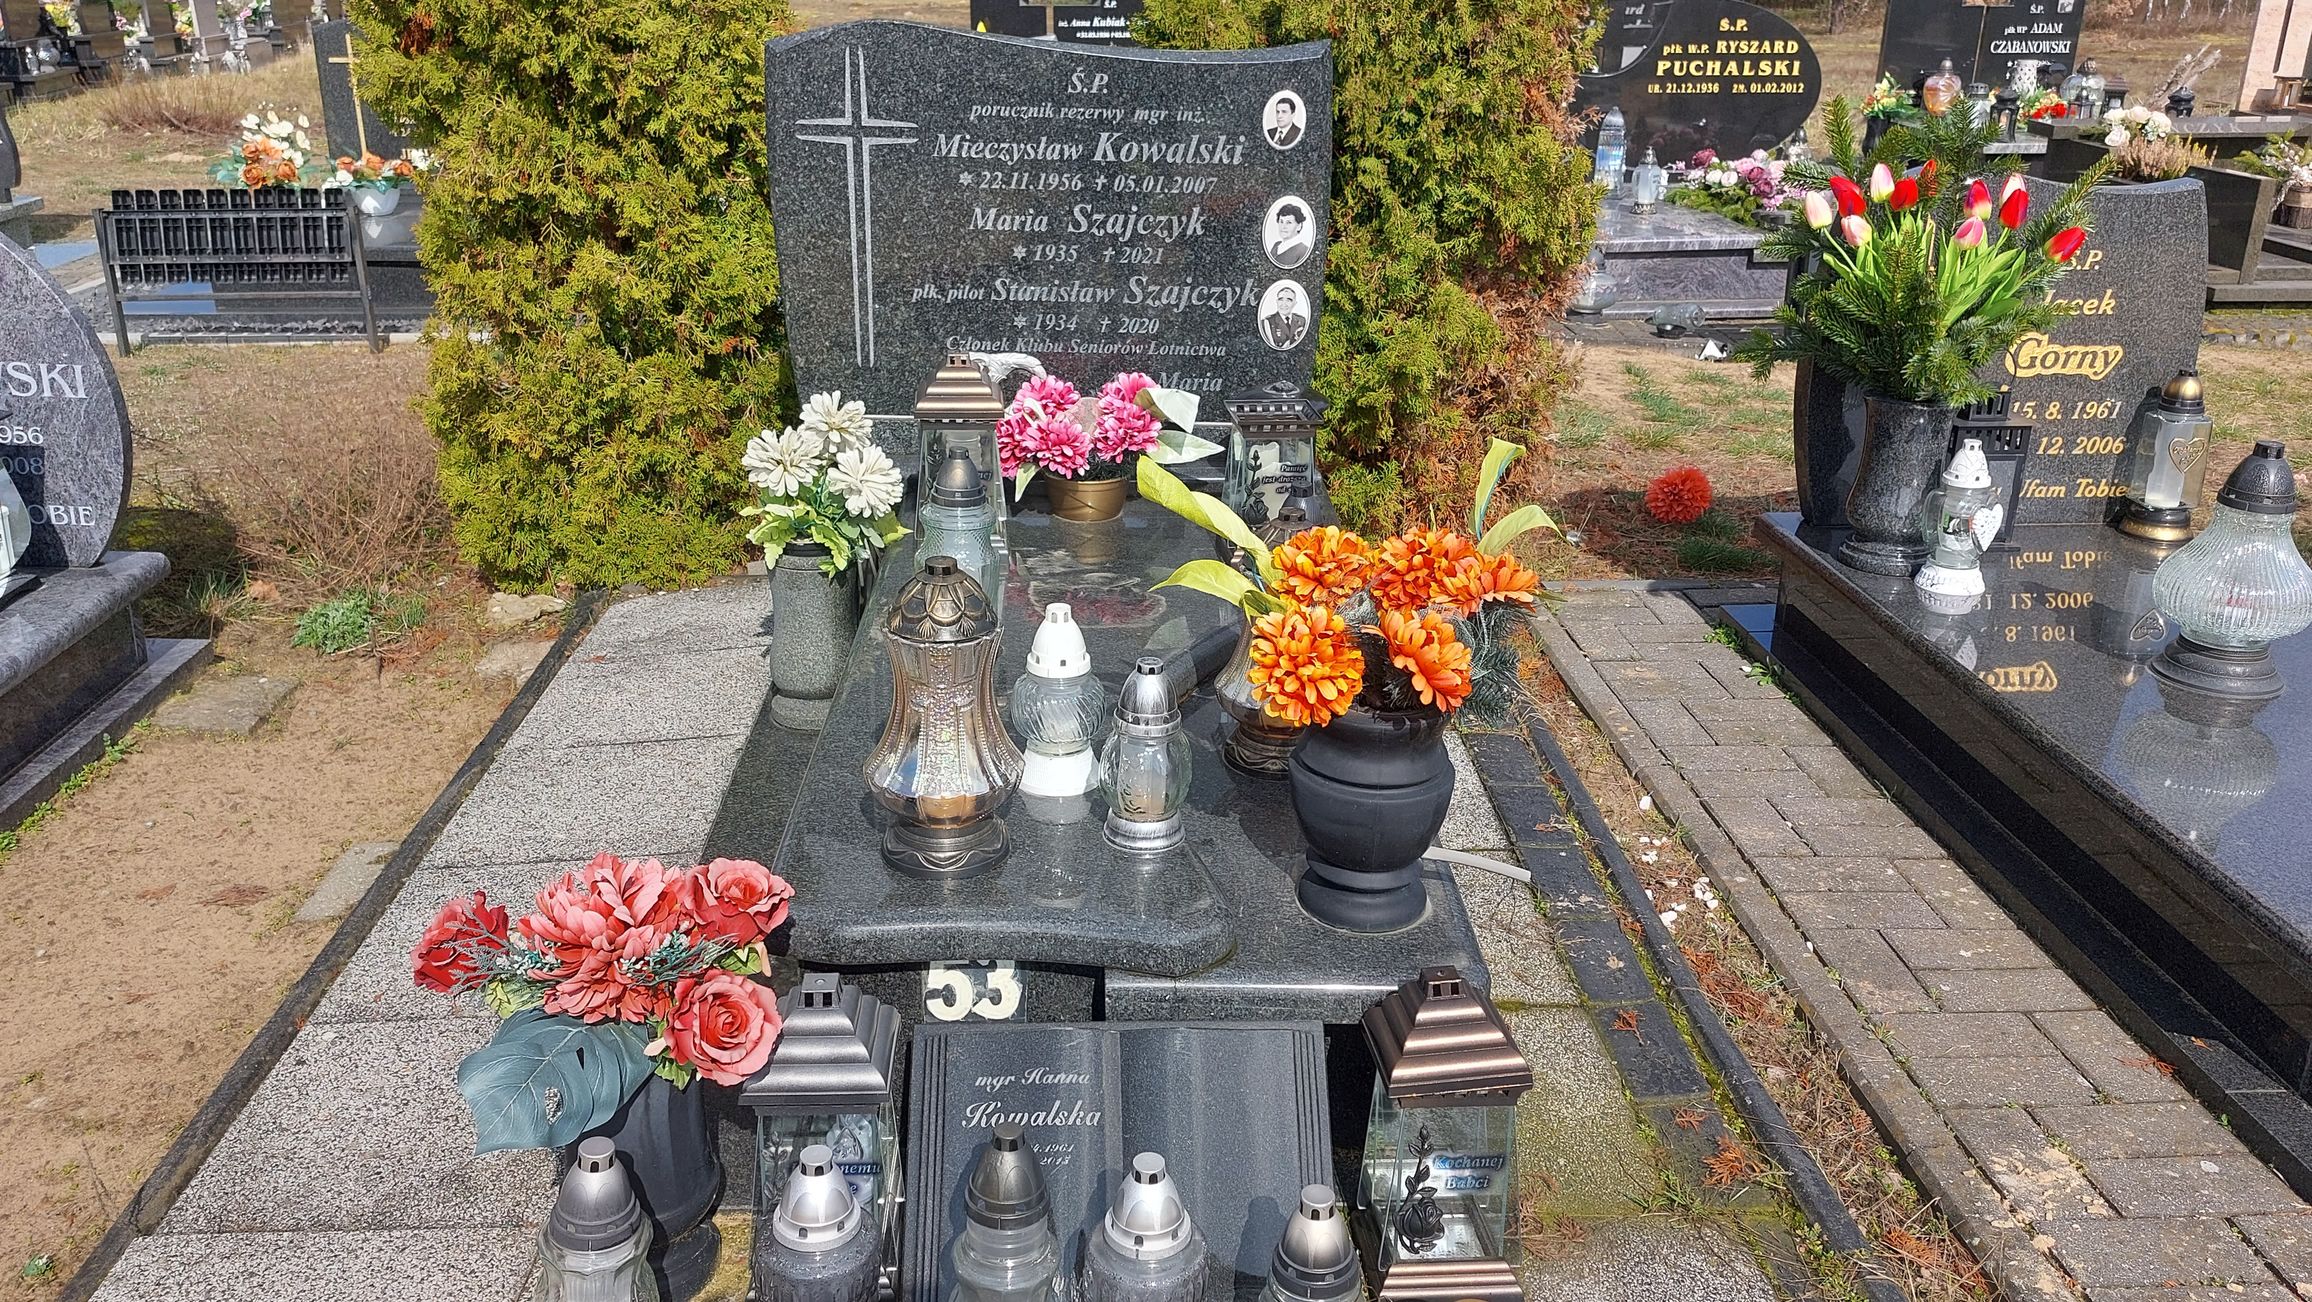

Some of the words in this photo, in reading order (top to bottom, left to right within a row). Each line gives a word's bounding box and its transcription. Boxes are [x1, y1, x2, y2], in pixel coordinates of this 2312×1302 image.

[1719, 17, 1749, 32] Ś.P.
[2029, 22, 2063, 34] ADAM
[1662, 43, 1684, 56] płk
[1687, 44, 1710, 55] W.P.
[1715, 39, 1799, 54] RYSZARD
[1990, 40, 2072, 54] CZABANOWSKI
[1656, 59, 1801, 77] PUCHALSKI
[1067, 67, 1109, 94] Ś.P.
[1647, 83, 1664, 94] UR.
[1665, 82, 1720, 94] 21.12.1936
[1749, 83, 1805, 95] 01.02.2012
[970, 101, 1055, 123] porucznik
[1059, 106, 1125, 124] rezerwy
[1133, 108, 1169, 125] mgr
[931, 132, 1083, 167] Mieczysław
[1091, 131, 1248, 166] Kowalski
[979, 171, 1083, 192] 22.11.1956
[1113, 174, 1218, 194] 05.01.2007
[967, 206, 1049, 233] Maria
[1067, 203, 1206, 243] Szajczyk
[1033, 244, 1079, 263] 1935
[1119, 246, 1165, 265] 2021
[910, 286, 944, 303] płk.
[946, 286, 985, 304] pilot
[990, 277, 1116, 303] Stanisław
[1123, 274, 1263, 313] Szajczyk
[1033, 313, 1079, 332] 1934
[1118, 316, 1160, 335] 2020
[946, 334, 1010, 353] Członek
[1015, 336, 1064, 353] Klubu
[1067, 337, 1145, 355] Seniorów
[1147, 339, 1227, 357] Lotnictwa
[0, 361, 89, 400] SKI
[1158, 371, 1223, 392] Maria
[2044, 401, 2063, 420] 8.
[2070, 401, 2122, 420] 1961
[2036, 436, 2066, 455] 12.
[2072, 436, 2127, 455] 2006
[28, 504, 96, 527] OBIE
[924, 960, 1024, 1022] 53
[974, 1073, 1016, 1093] mgr
[1020, 1065, 1091, 1086] Hanna
[961, 1099, 1102, 1129] Kowalska
[1433, 1154, 1506, 1172] Kochanej
[1445, 1175, 1490, 1190] Babci
